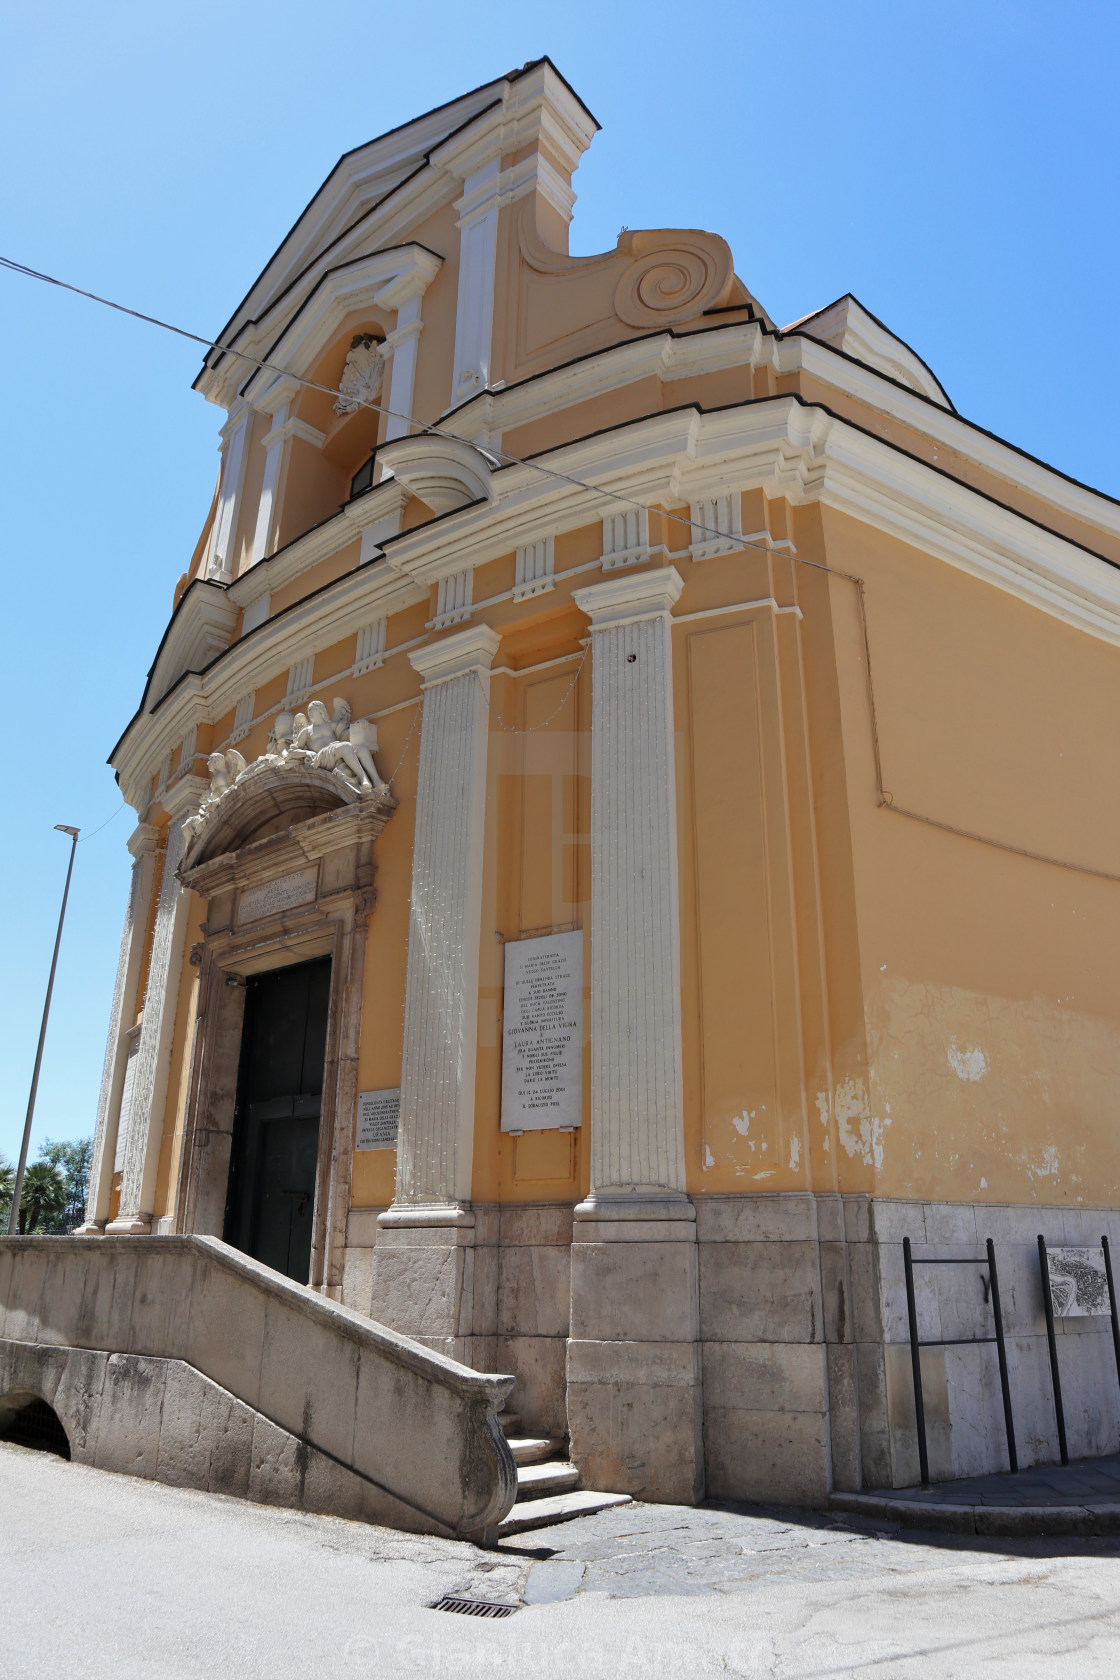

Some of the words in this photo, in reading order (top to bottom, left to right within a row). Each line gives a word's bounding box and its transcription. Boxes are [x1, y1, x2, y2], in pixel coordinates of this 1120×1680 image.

[508, 1026, 537, 1035] GIOVANNA
[559, 1021, 576, 1029] VIGNA
[515, 1040, 533, 1048] LAURA
[536, 1036, 570, 1046] ANTIGNANO
